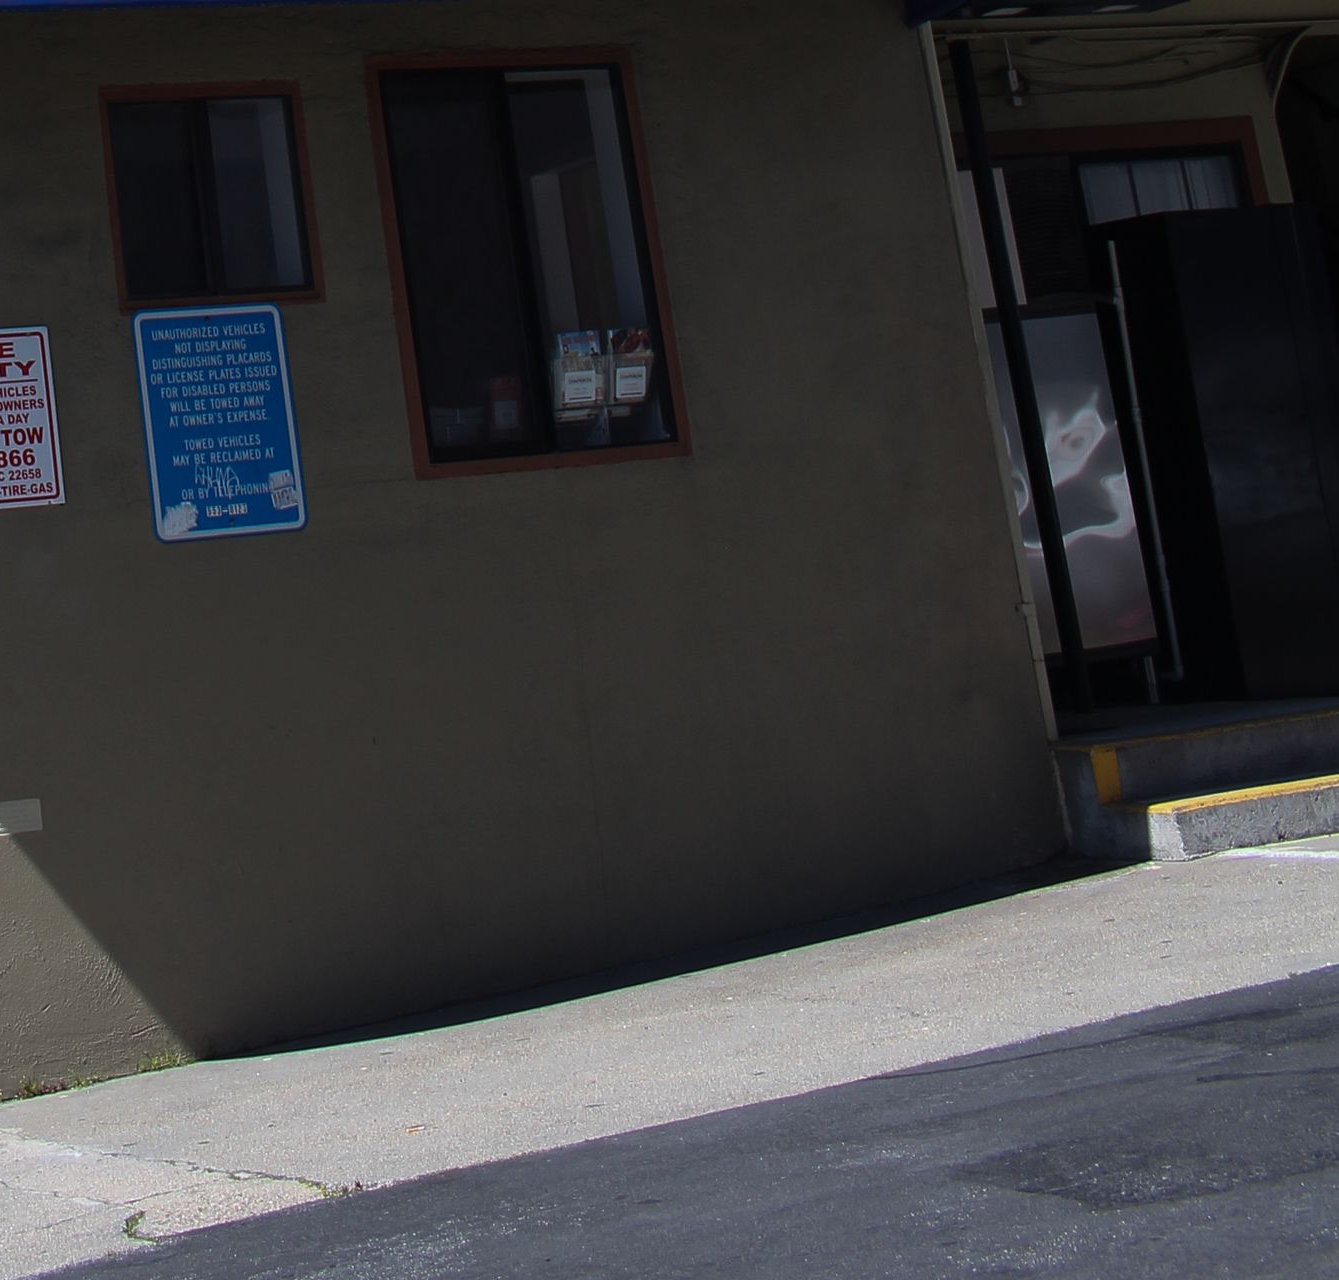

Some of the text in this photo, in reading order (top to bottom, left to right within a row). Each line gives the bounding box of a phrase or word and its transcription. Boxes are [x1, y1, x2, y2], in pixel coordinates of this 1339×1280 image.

[151, 323, 266, 341] UNAUTHORIZED VEHICLES
[174, 338, 247, 354] NOT DISPLAYING
[152, 351, 272, 370] DISTINGUISHING PLACARDS
[150, 365, 277, 385] OR LICENSE PLATES ISSUED
[161, 379, 271, 399] FOR DISABLED PERSONS
[169, 395, 265, 413] WILL BE TOWED AWAY
[7, 413, 30, 424] DAY
[169, 416, 179, 428] AT
[183, 412, 223, 426] OWNER'S
[0, 427, 44, 445] TOW
[184, 434, 261, 451] TOWED VEHICLES
[172, 447, 275, 467] MAY BE RECLAIMED AT
[9, 468, 42, 481] 22658
[182, 488, 194, 501] OR
[198, 487, 209, 499] BY
